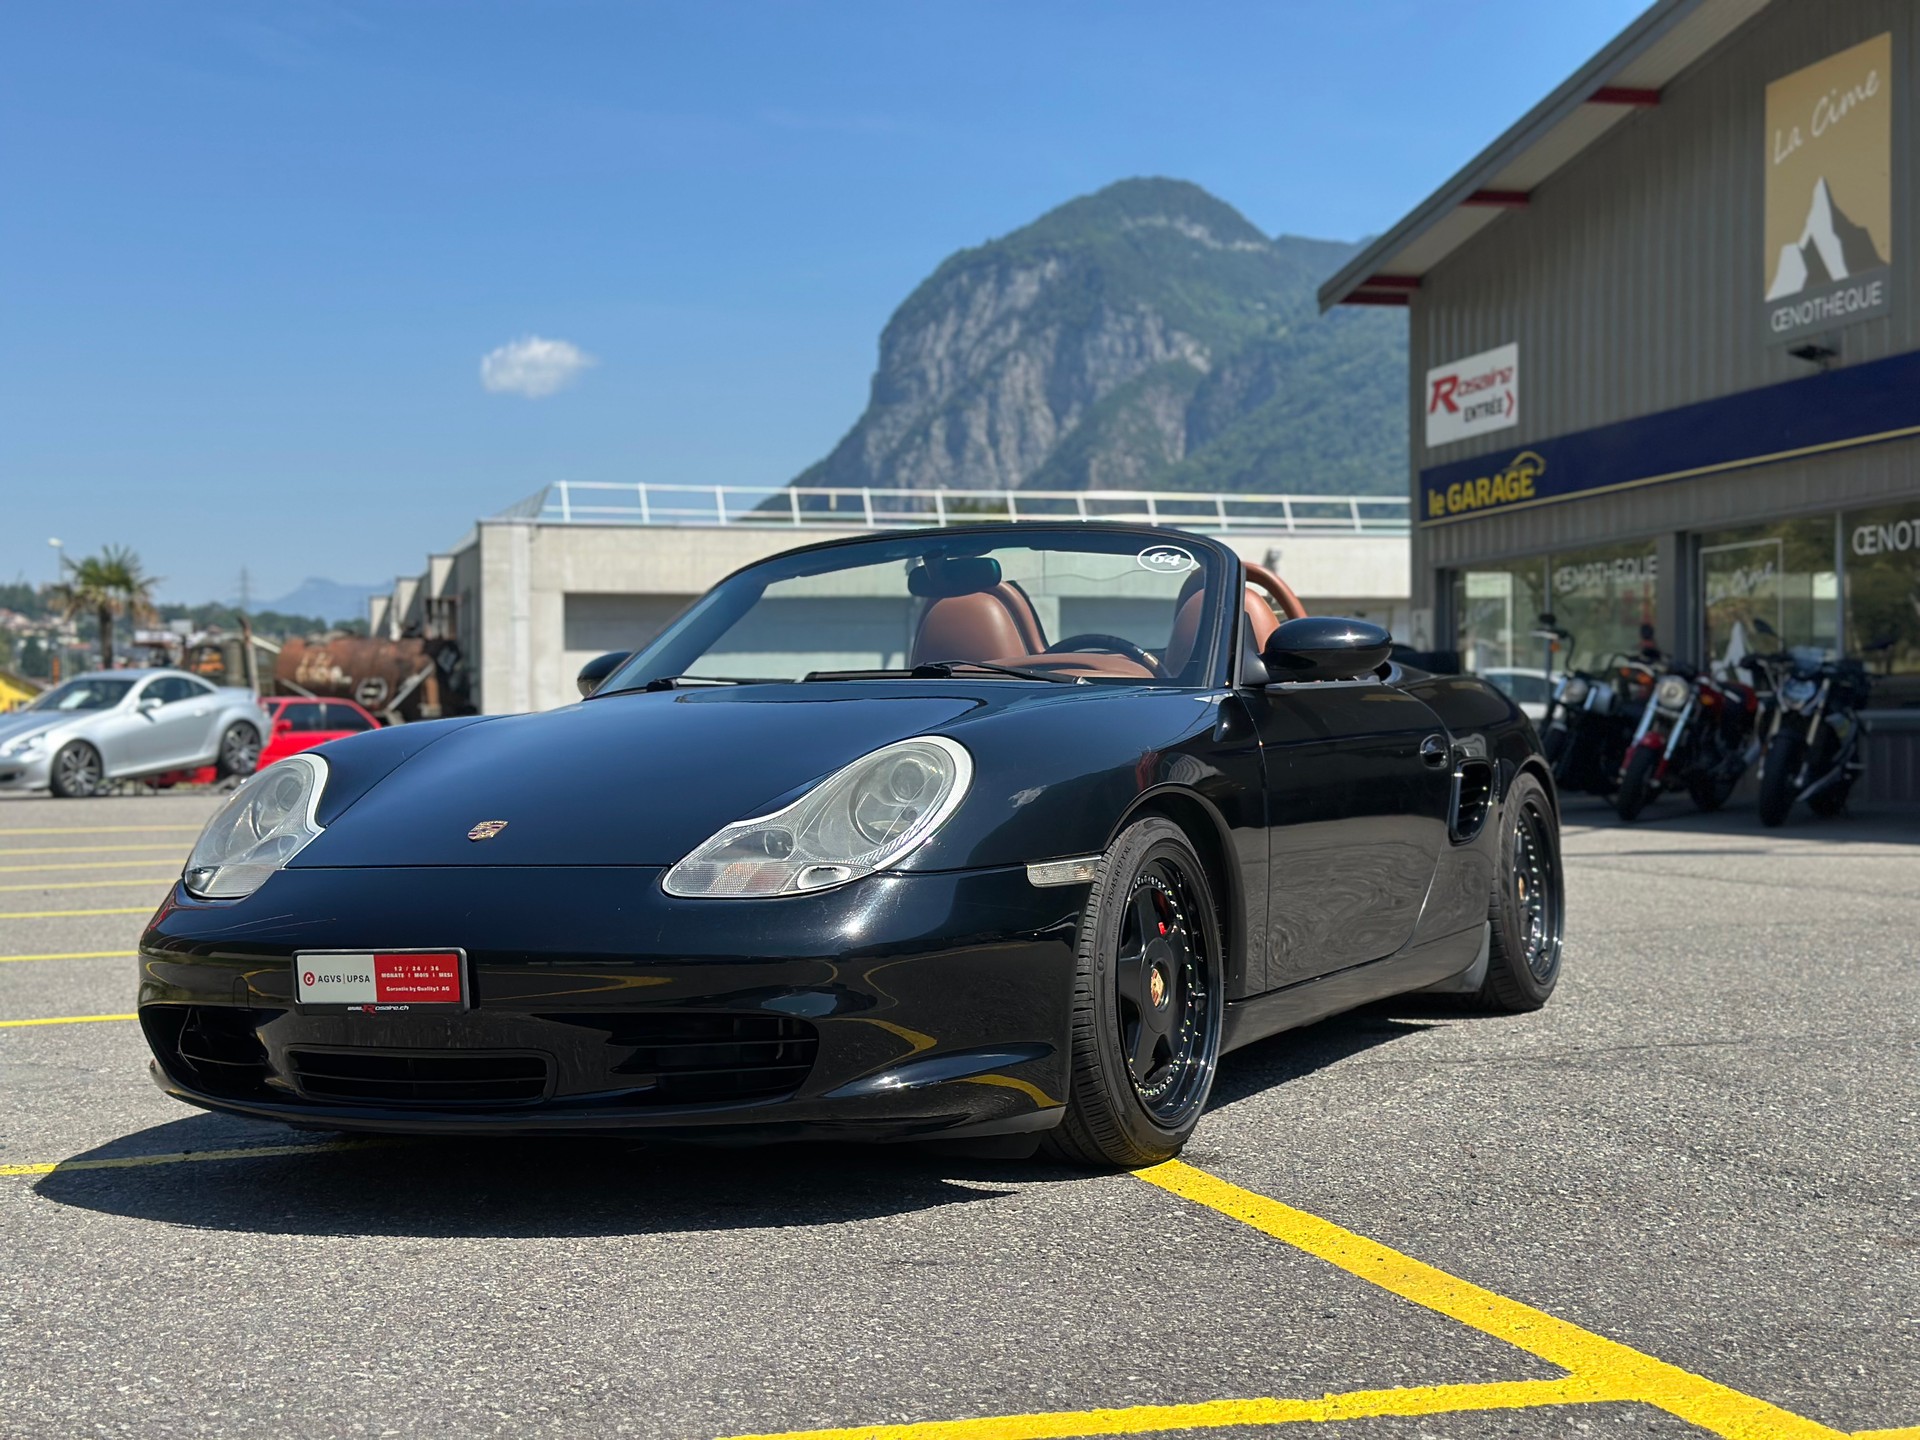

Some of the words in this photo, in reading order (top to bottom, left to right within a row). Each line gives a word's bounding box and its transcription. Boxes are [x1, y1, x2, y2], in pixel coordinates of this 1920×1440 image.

[1774, 126, 1803, 165] La
[1811, 70, 1880, 137] Cime
[1428, 366, 1513, 415] Rosaire
[1447, 468, 1535, 513] GARAGE
[1150, 552, 1181, 566] 64
